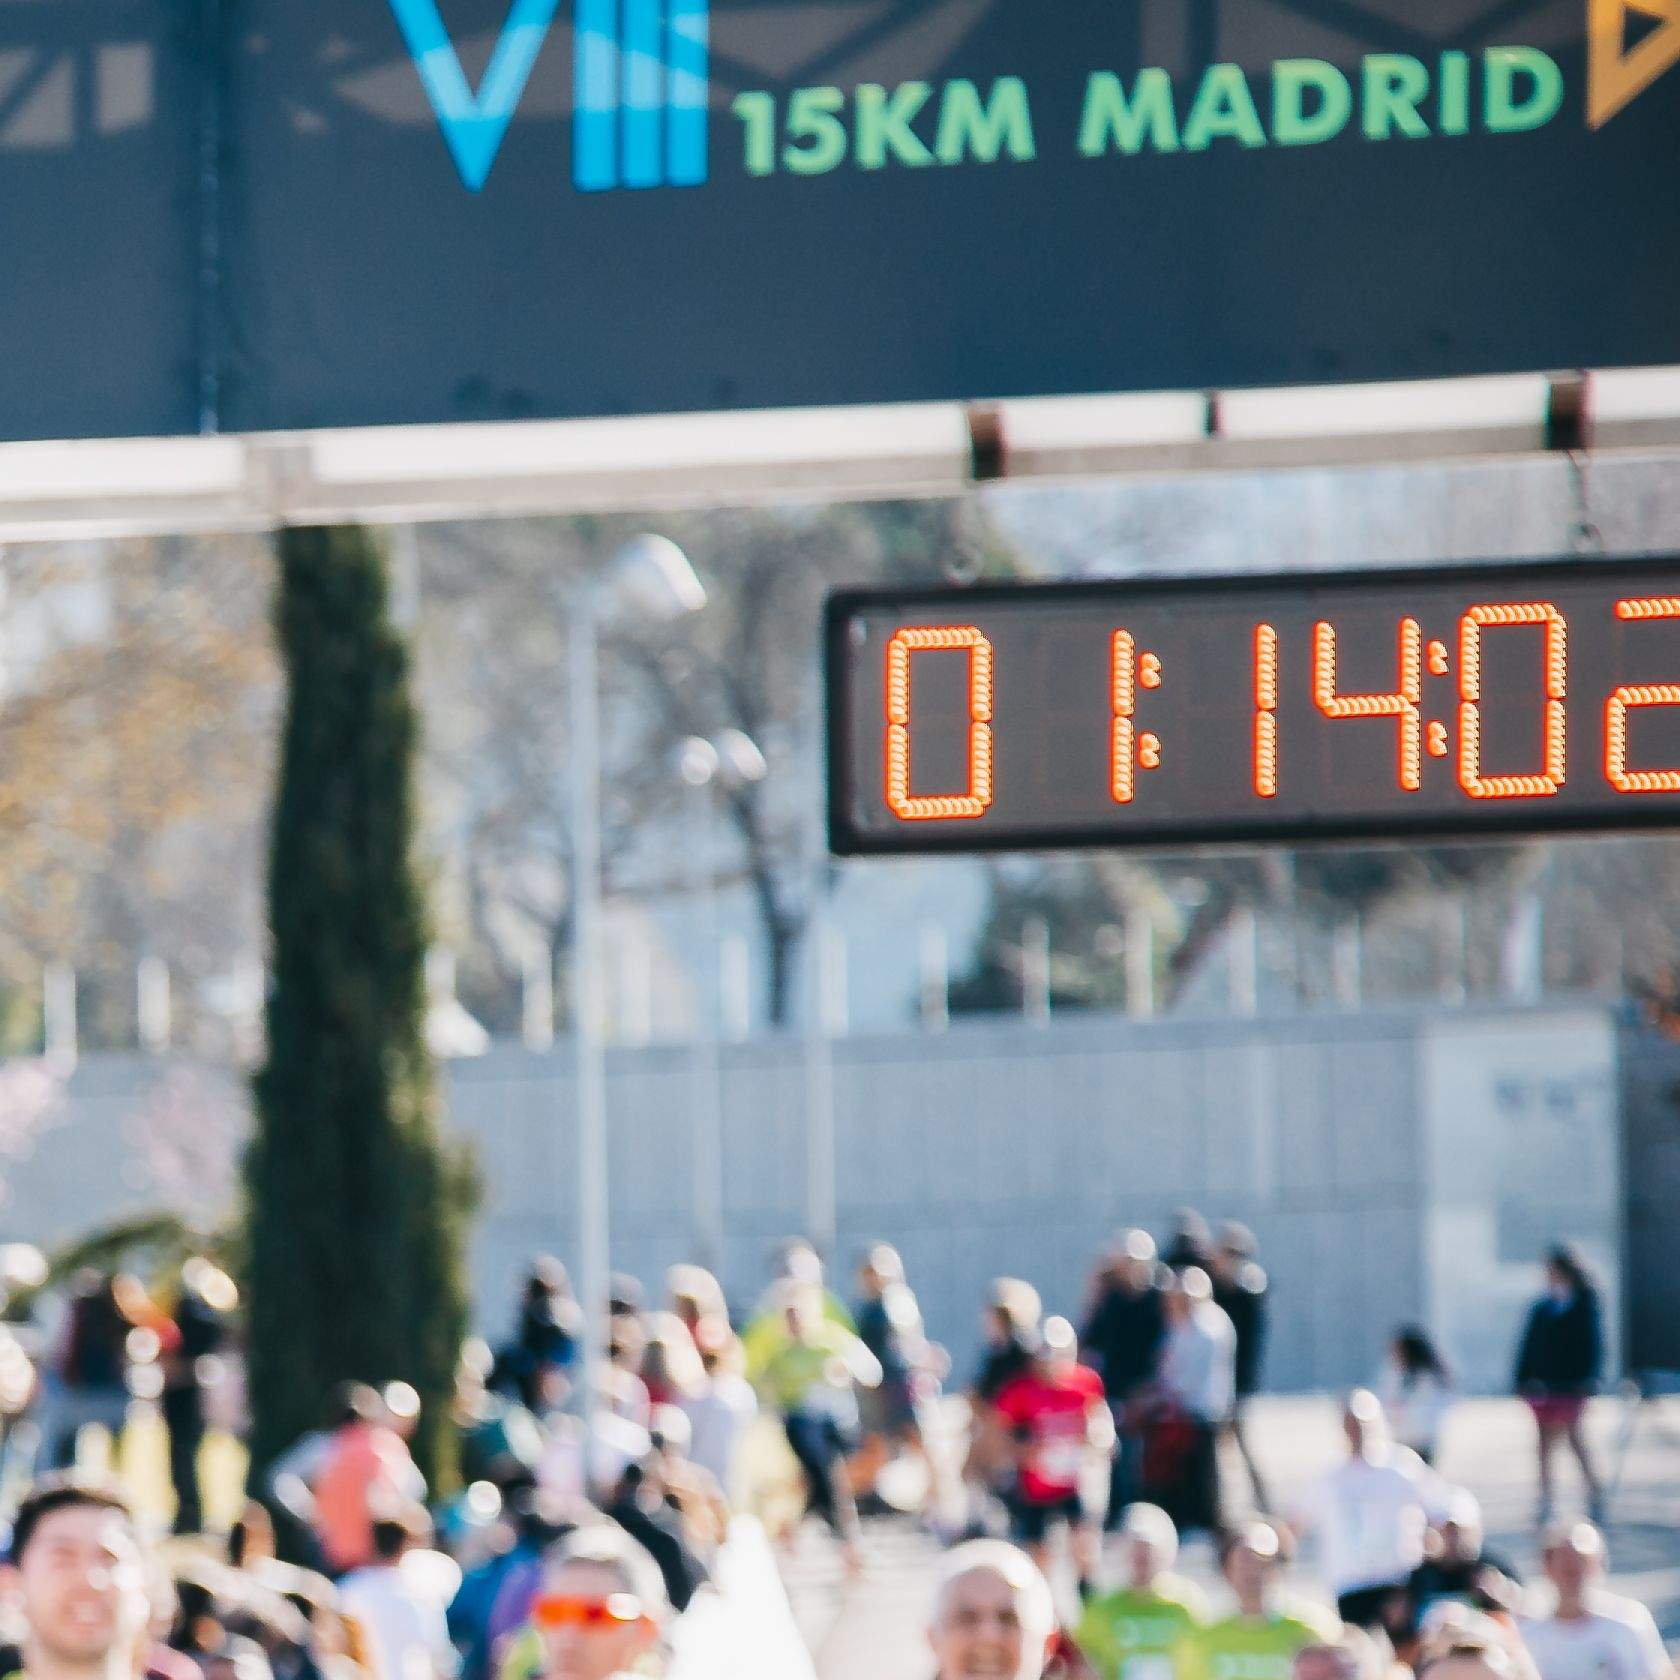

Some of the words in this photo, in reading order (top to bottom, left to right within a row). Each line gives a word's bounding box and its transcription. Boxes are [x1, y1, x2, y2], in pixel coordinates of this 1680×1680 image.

[388, 0, 709, 193] VIII
[734, 75, 1037, 178] 15KM
[1077, 45, 1564, 158] MADRID
